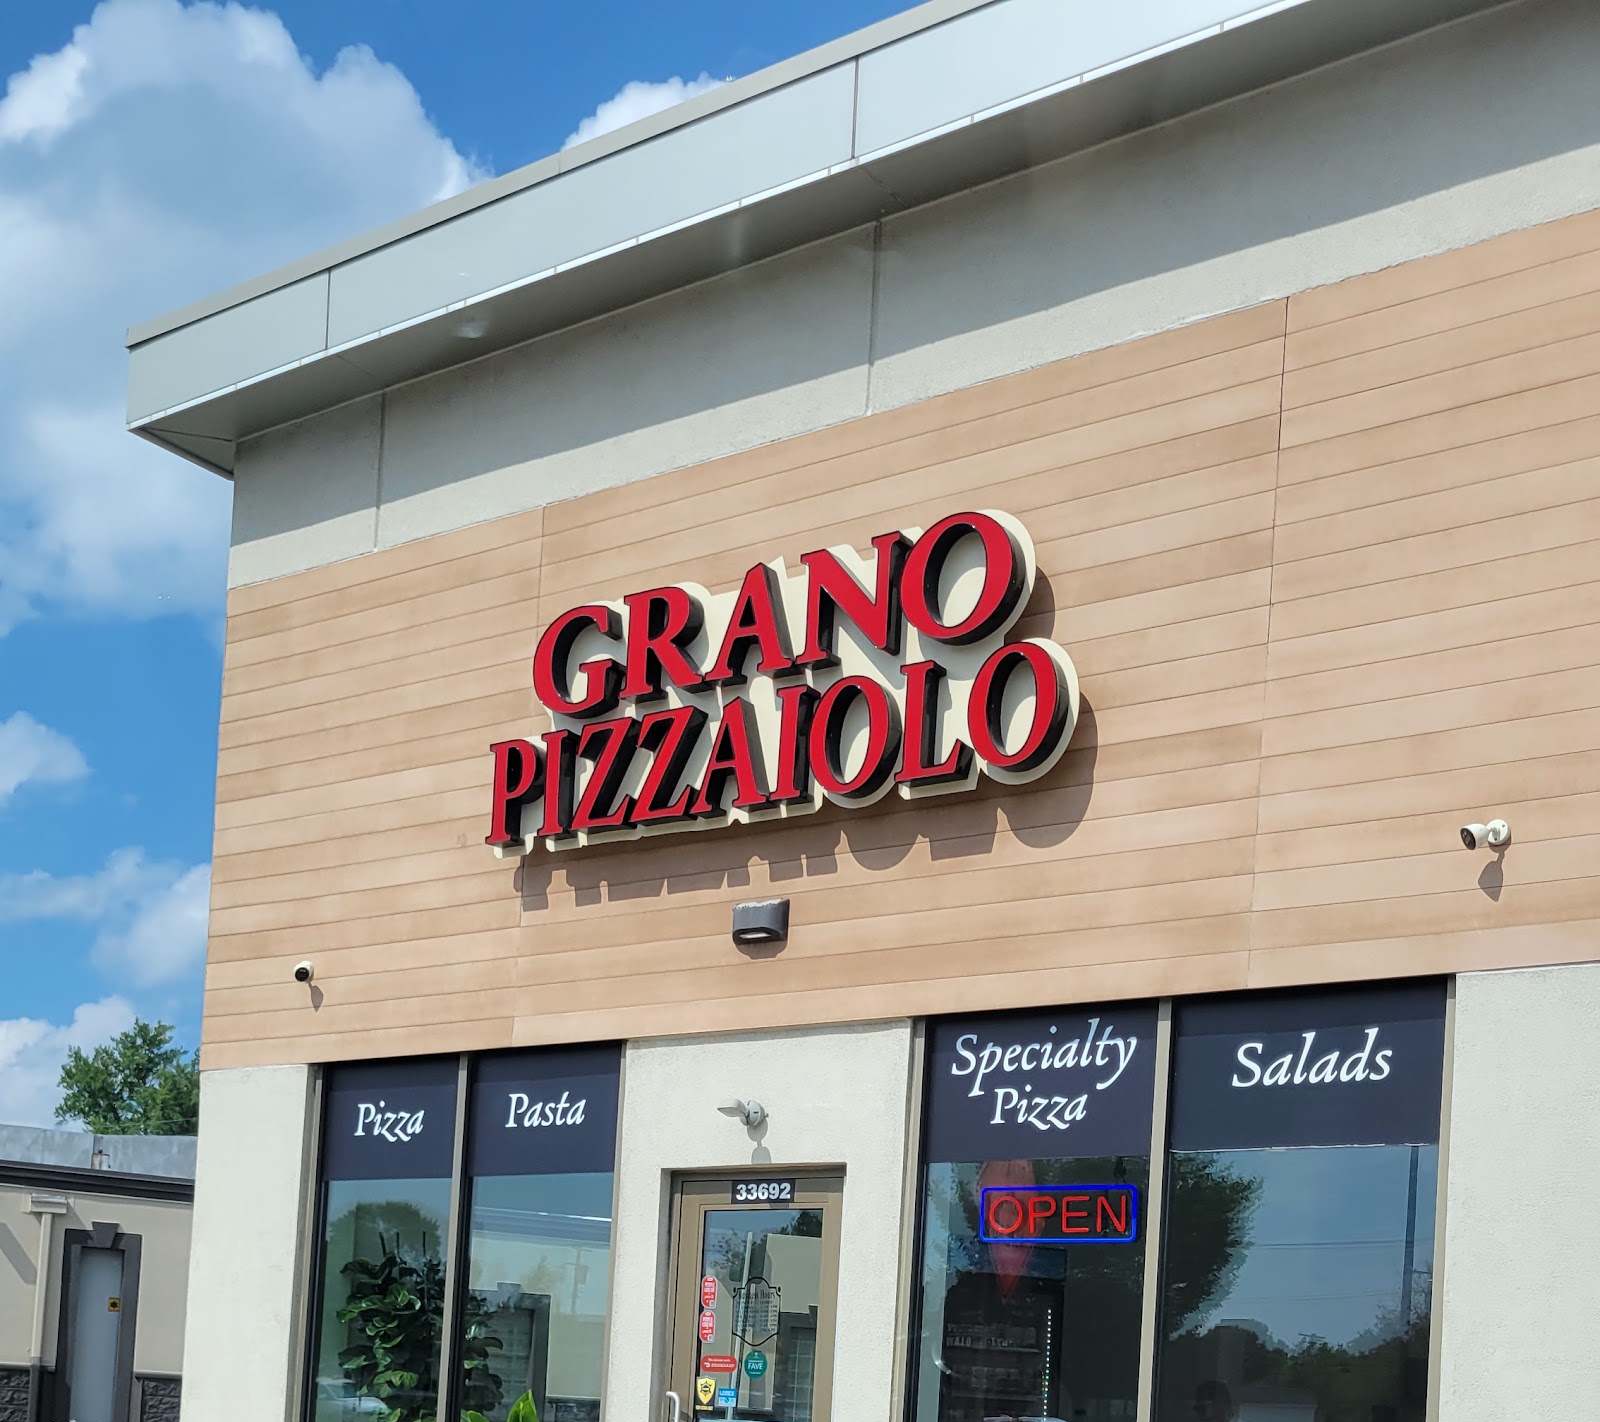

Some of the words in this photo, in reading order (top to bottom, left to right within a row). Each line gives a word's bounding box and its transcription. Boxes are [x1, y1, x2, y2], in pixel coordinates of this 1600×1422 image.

[533, 512, 1016, 716] GRANO
[485, 642, 1060, 844] PIZZAIOLO
[951, 1017, 1138, 1097] Specialty
[1231, 1027, 1393, 1088] Salads
[353, 1100, 425, 1143] Pizza
[504, 1091, 587, 1128] Pasta
[989, 1084, 1089, 1131] Pizza
[735, 1182, 791, 1201] 33692
[988, 1195, 1127, 1234] OPEN
[747, 1362, 764, 1370] FAVE
